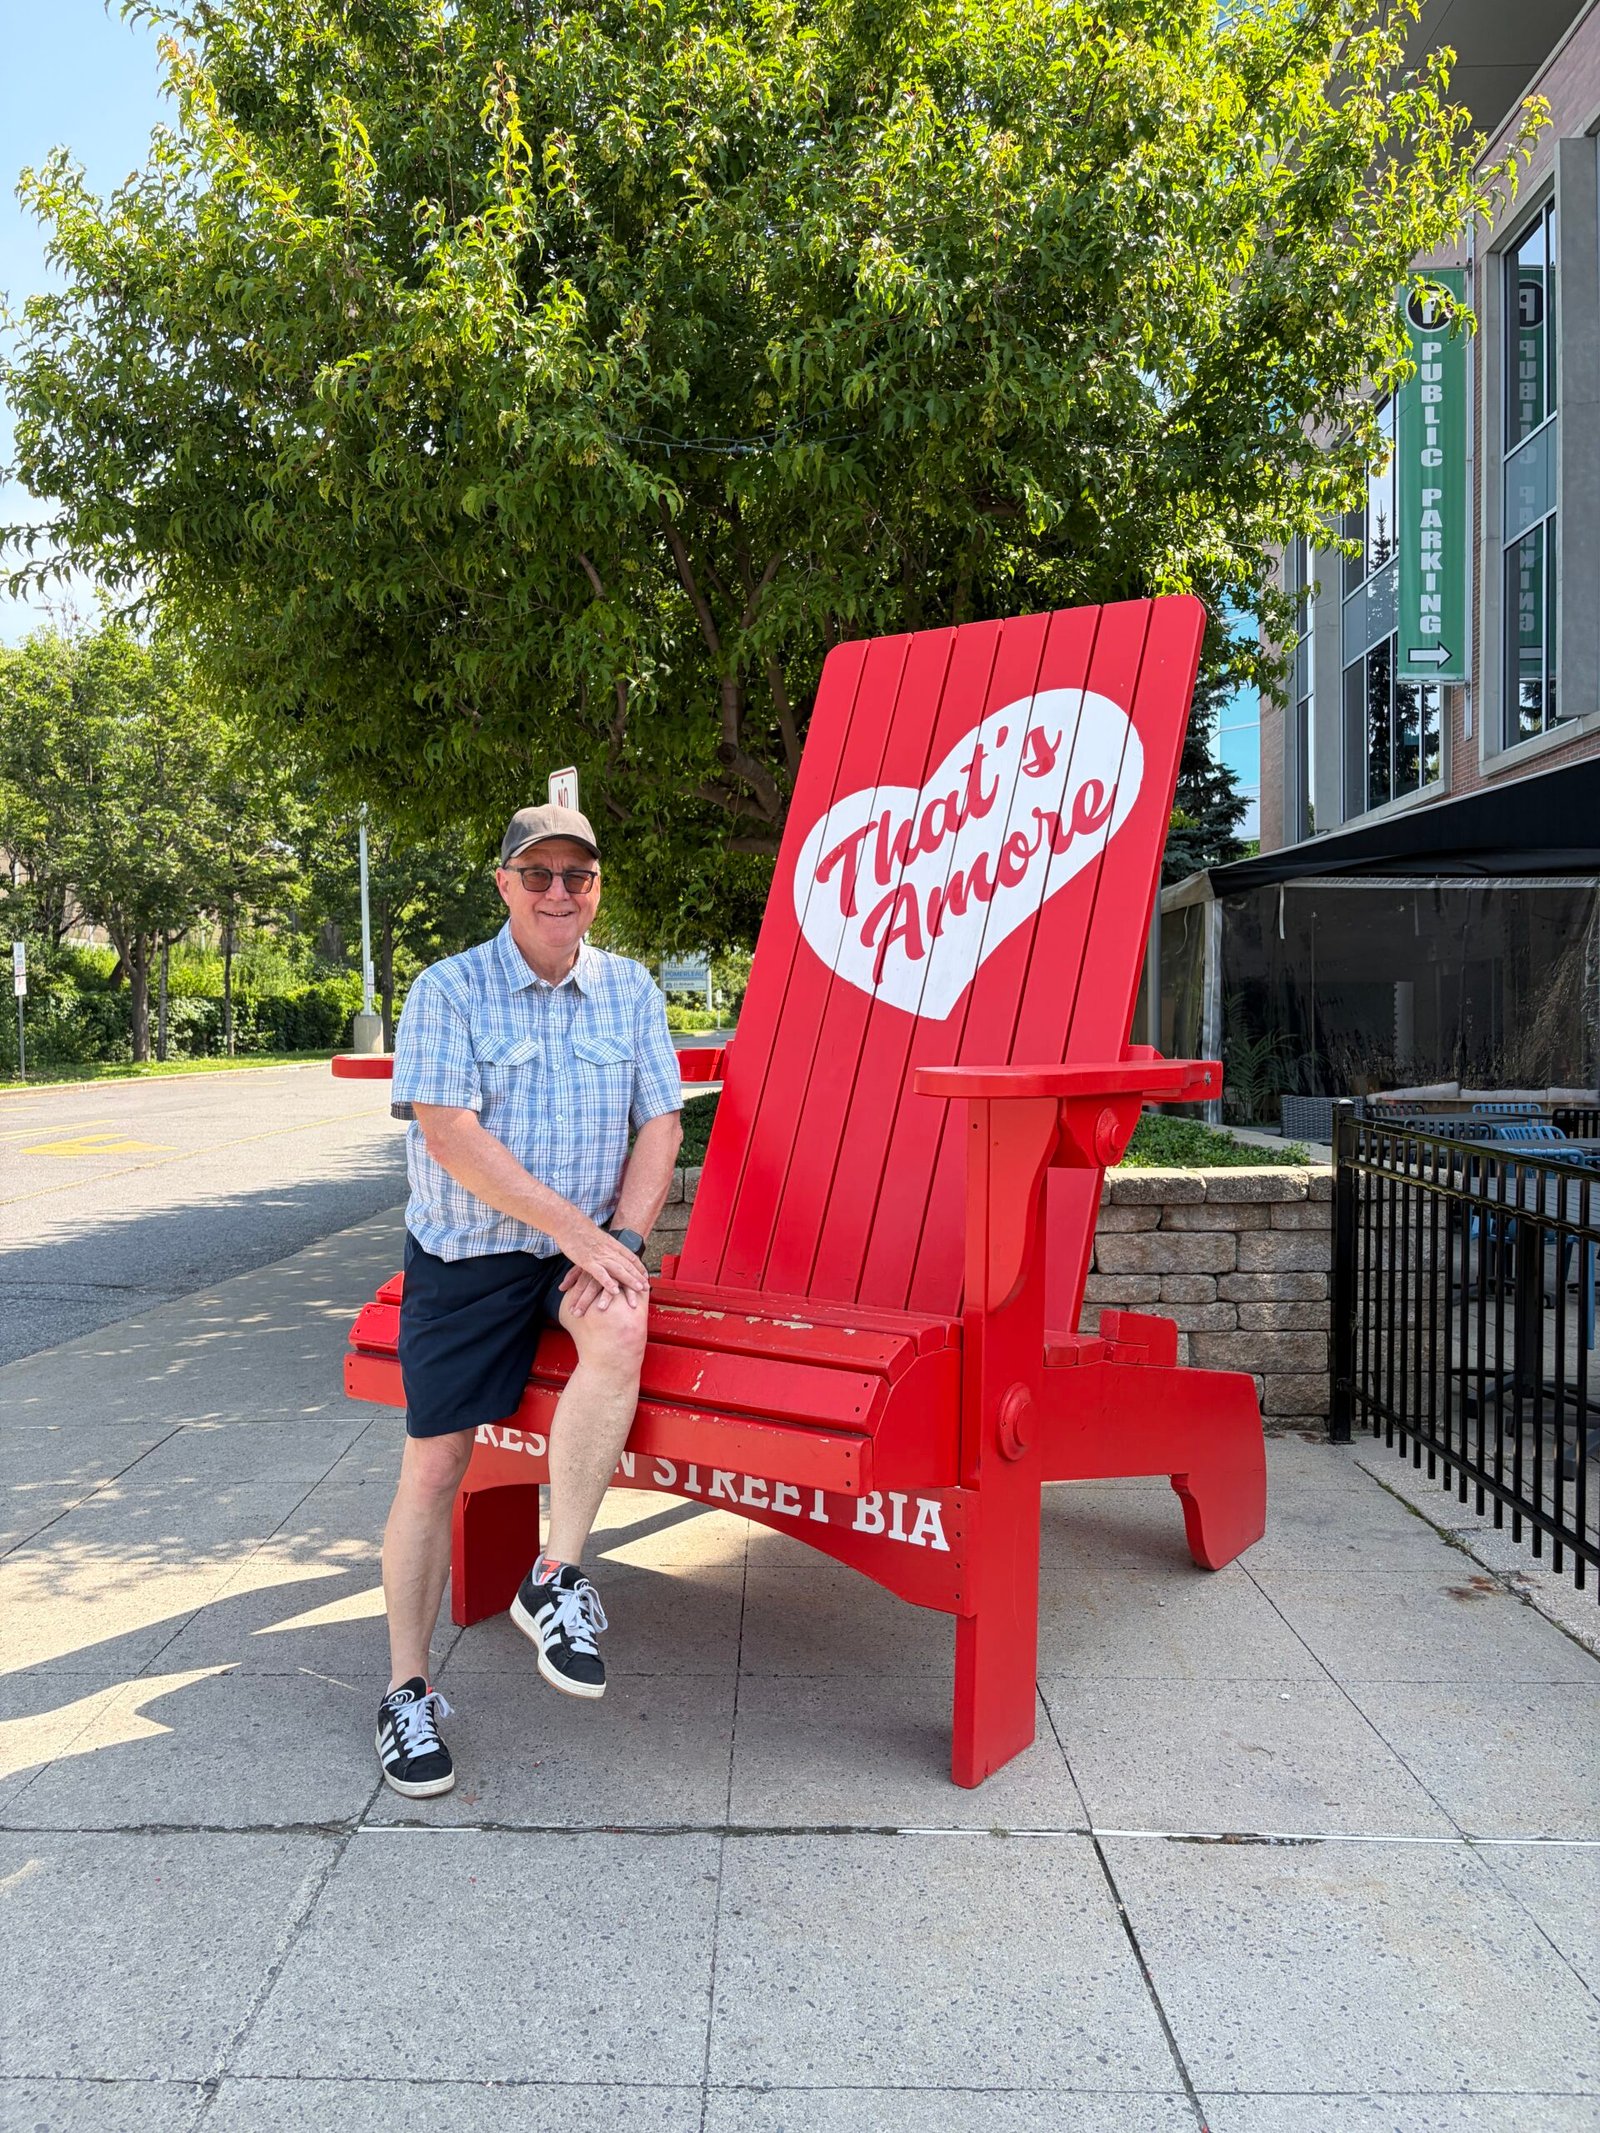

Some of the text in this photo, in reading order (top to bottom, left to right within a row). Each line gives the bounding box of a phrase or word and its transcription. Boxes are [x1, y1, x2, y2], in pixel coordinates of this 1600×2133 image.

[1419, 341, 1443, 634] PUBLIC PARKING
[557, 786, 569, 809] NO
[815, 725, 1063, 918] That's
[860, 778, 1118, 986] Amore
[851, 1490, 951, 1552] BIA
